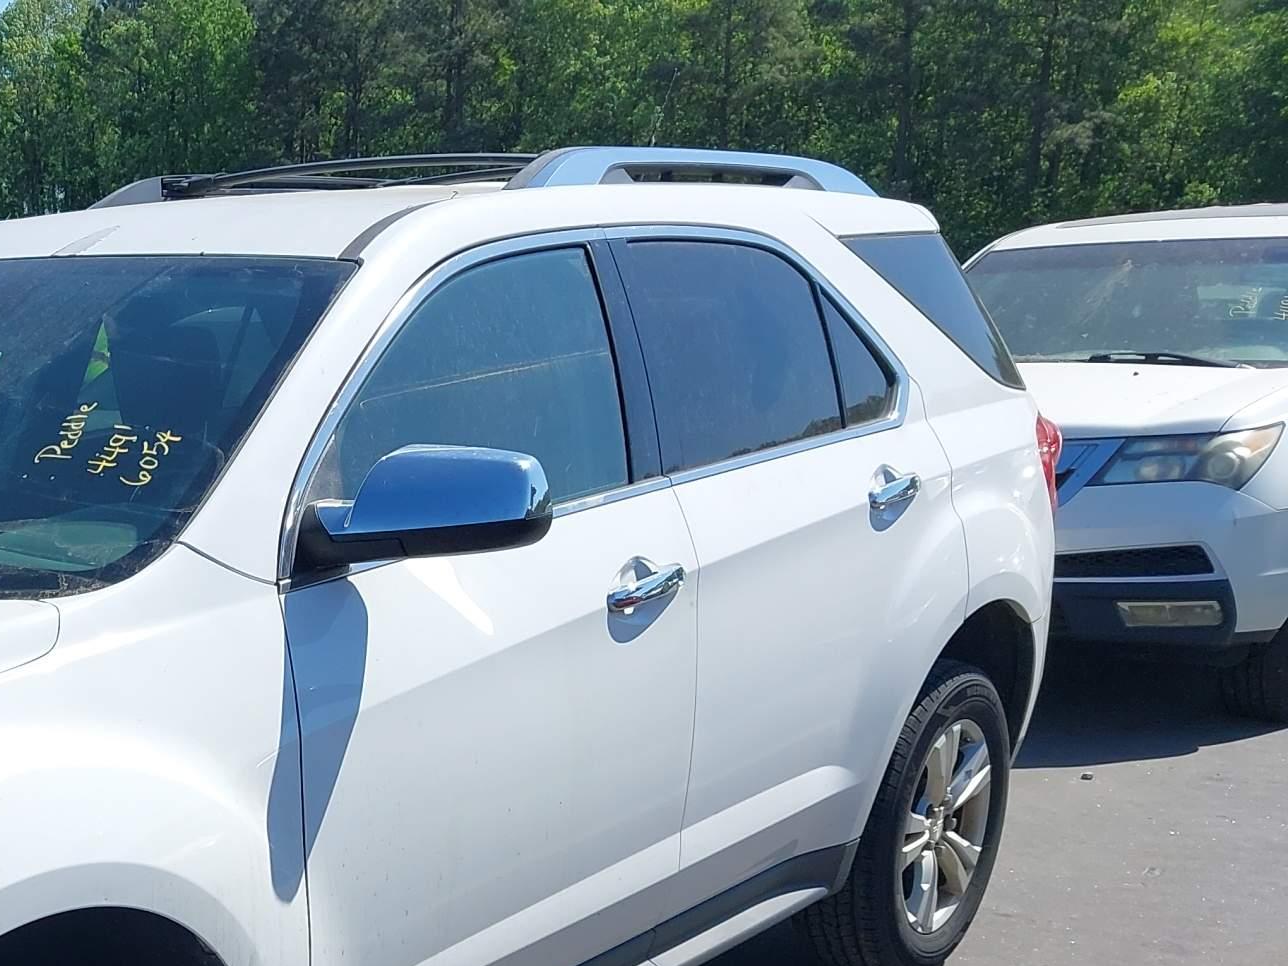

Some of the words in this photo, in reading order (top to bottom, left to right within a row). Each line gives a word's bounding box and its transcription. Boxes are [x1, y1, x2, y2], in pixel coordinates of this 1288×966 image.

[34, 402, 98, 463] Peddle
[87, 424, 138, 474] 4491
[119, 430, 182, 486] 6054
